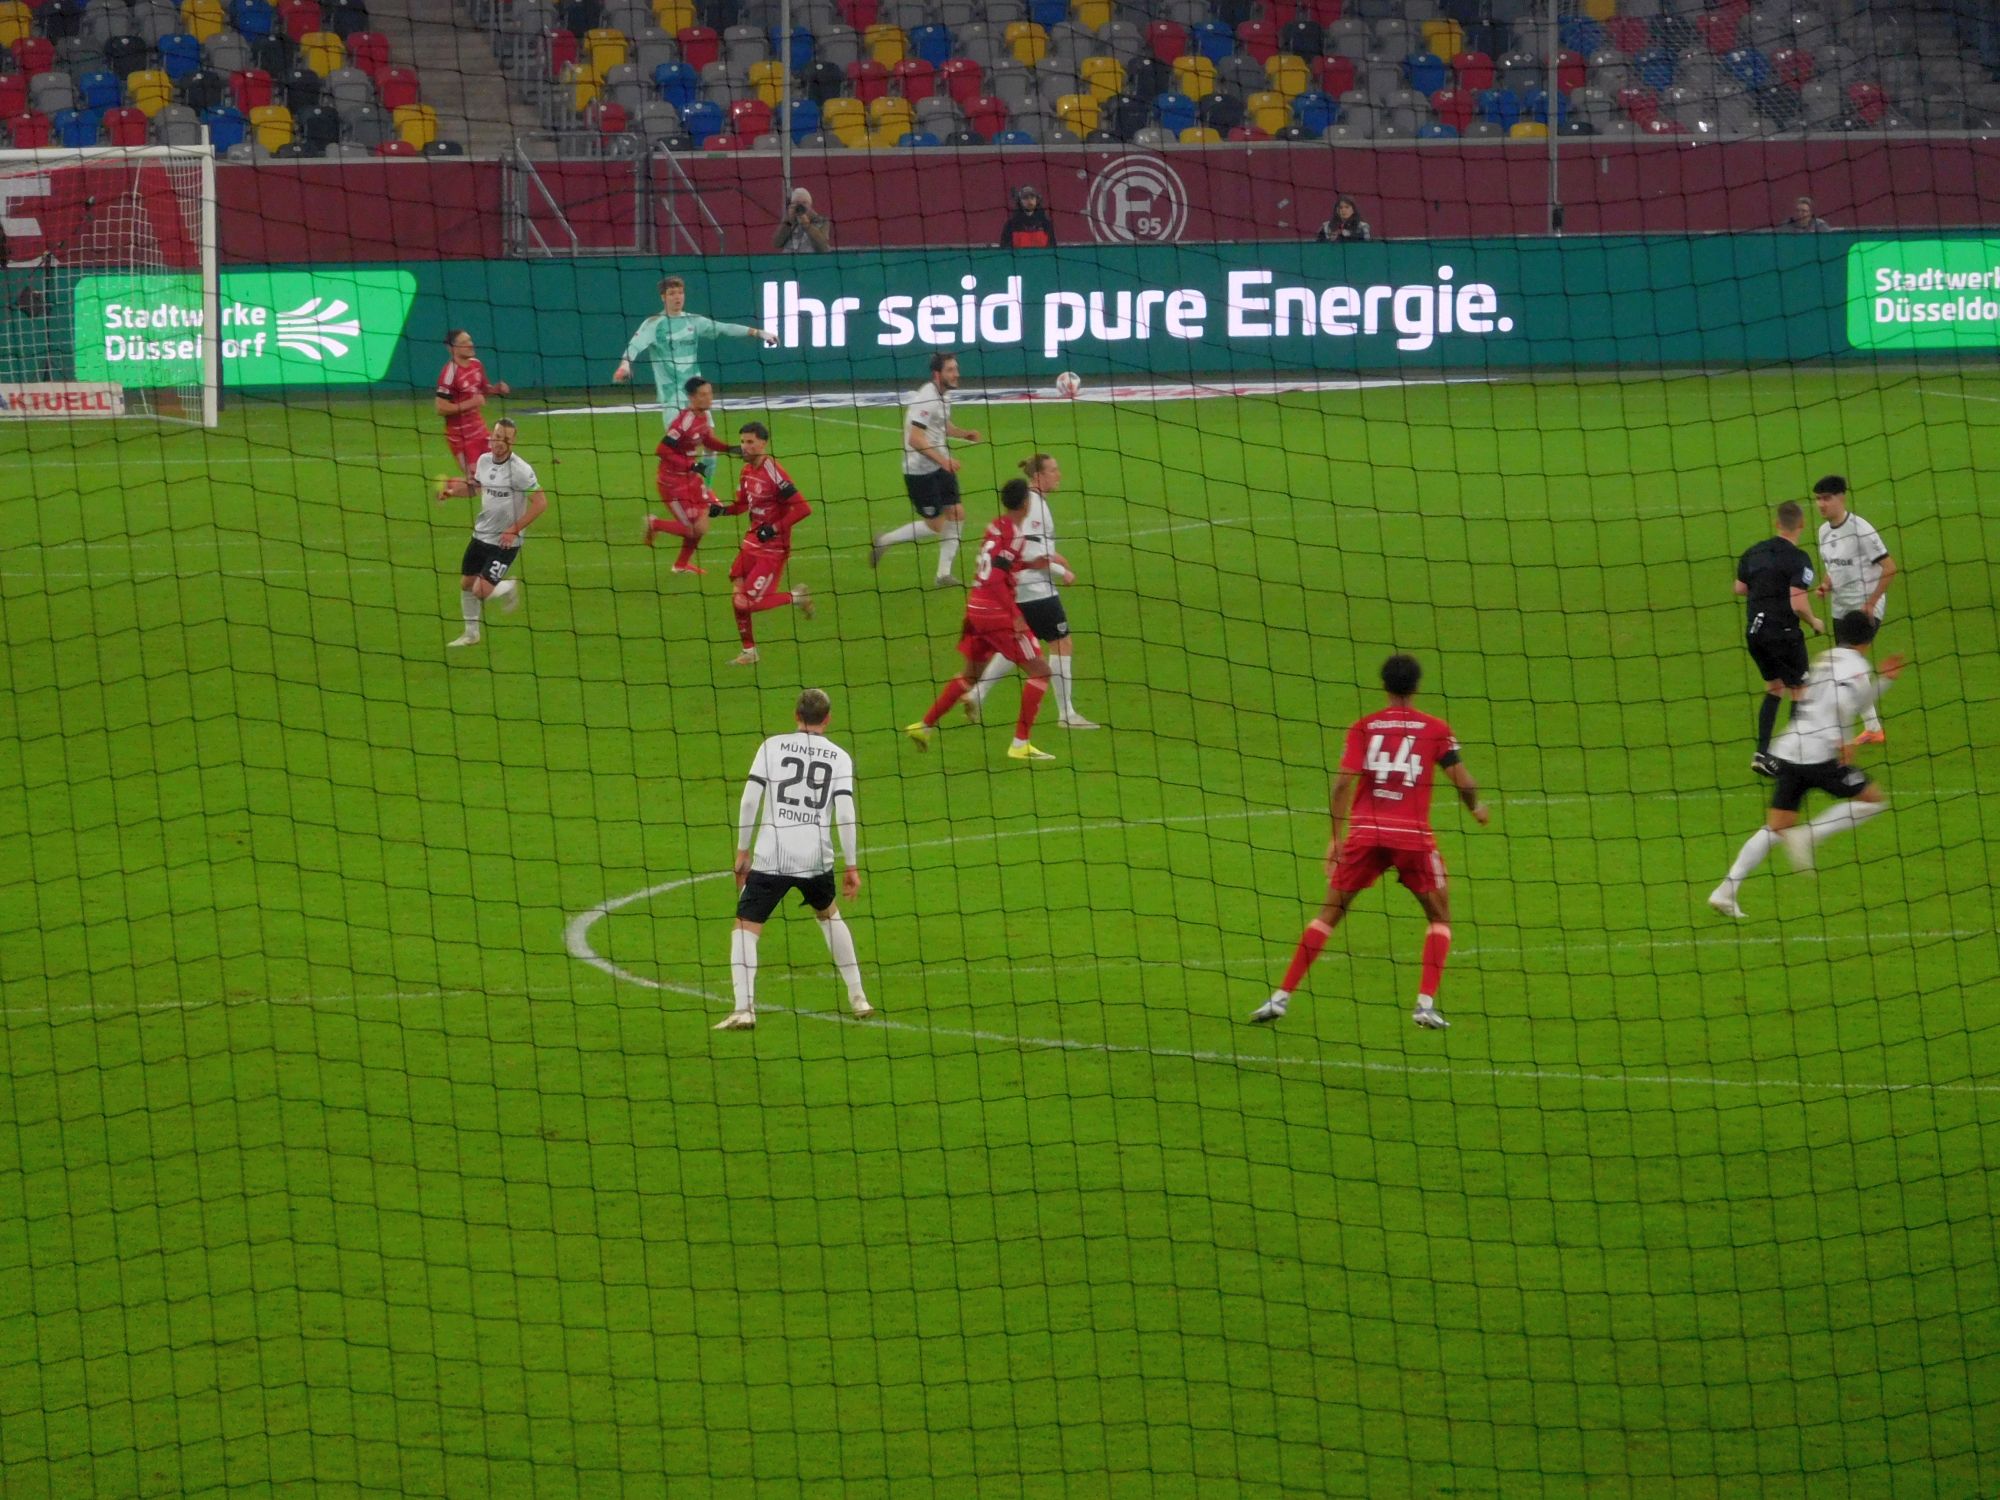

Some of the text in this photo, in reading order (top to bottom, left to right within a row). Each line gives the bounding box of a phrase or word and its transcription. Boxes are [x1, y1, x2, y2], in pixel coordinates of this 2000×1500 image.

[1137, 217, 1162, 235] 95
[104, 302, 267, 329] Stadtwrke
[763, 265, 1514, 358] Ihr seid pure Energie.
[1875, 296, 2000, 323] Düsseldo
[104, 332, 267, 361] Düsselorf
[1363, 734, 1424, 787] 44
[776, 756, 833, 810] 29
